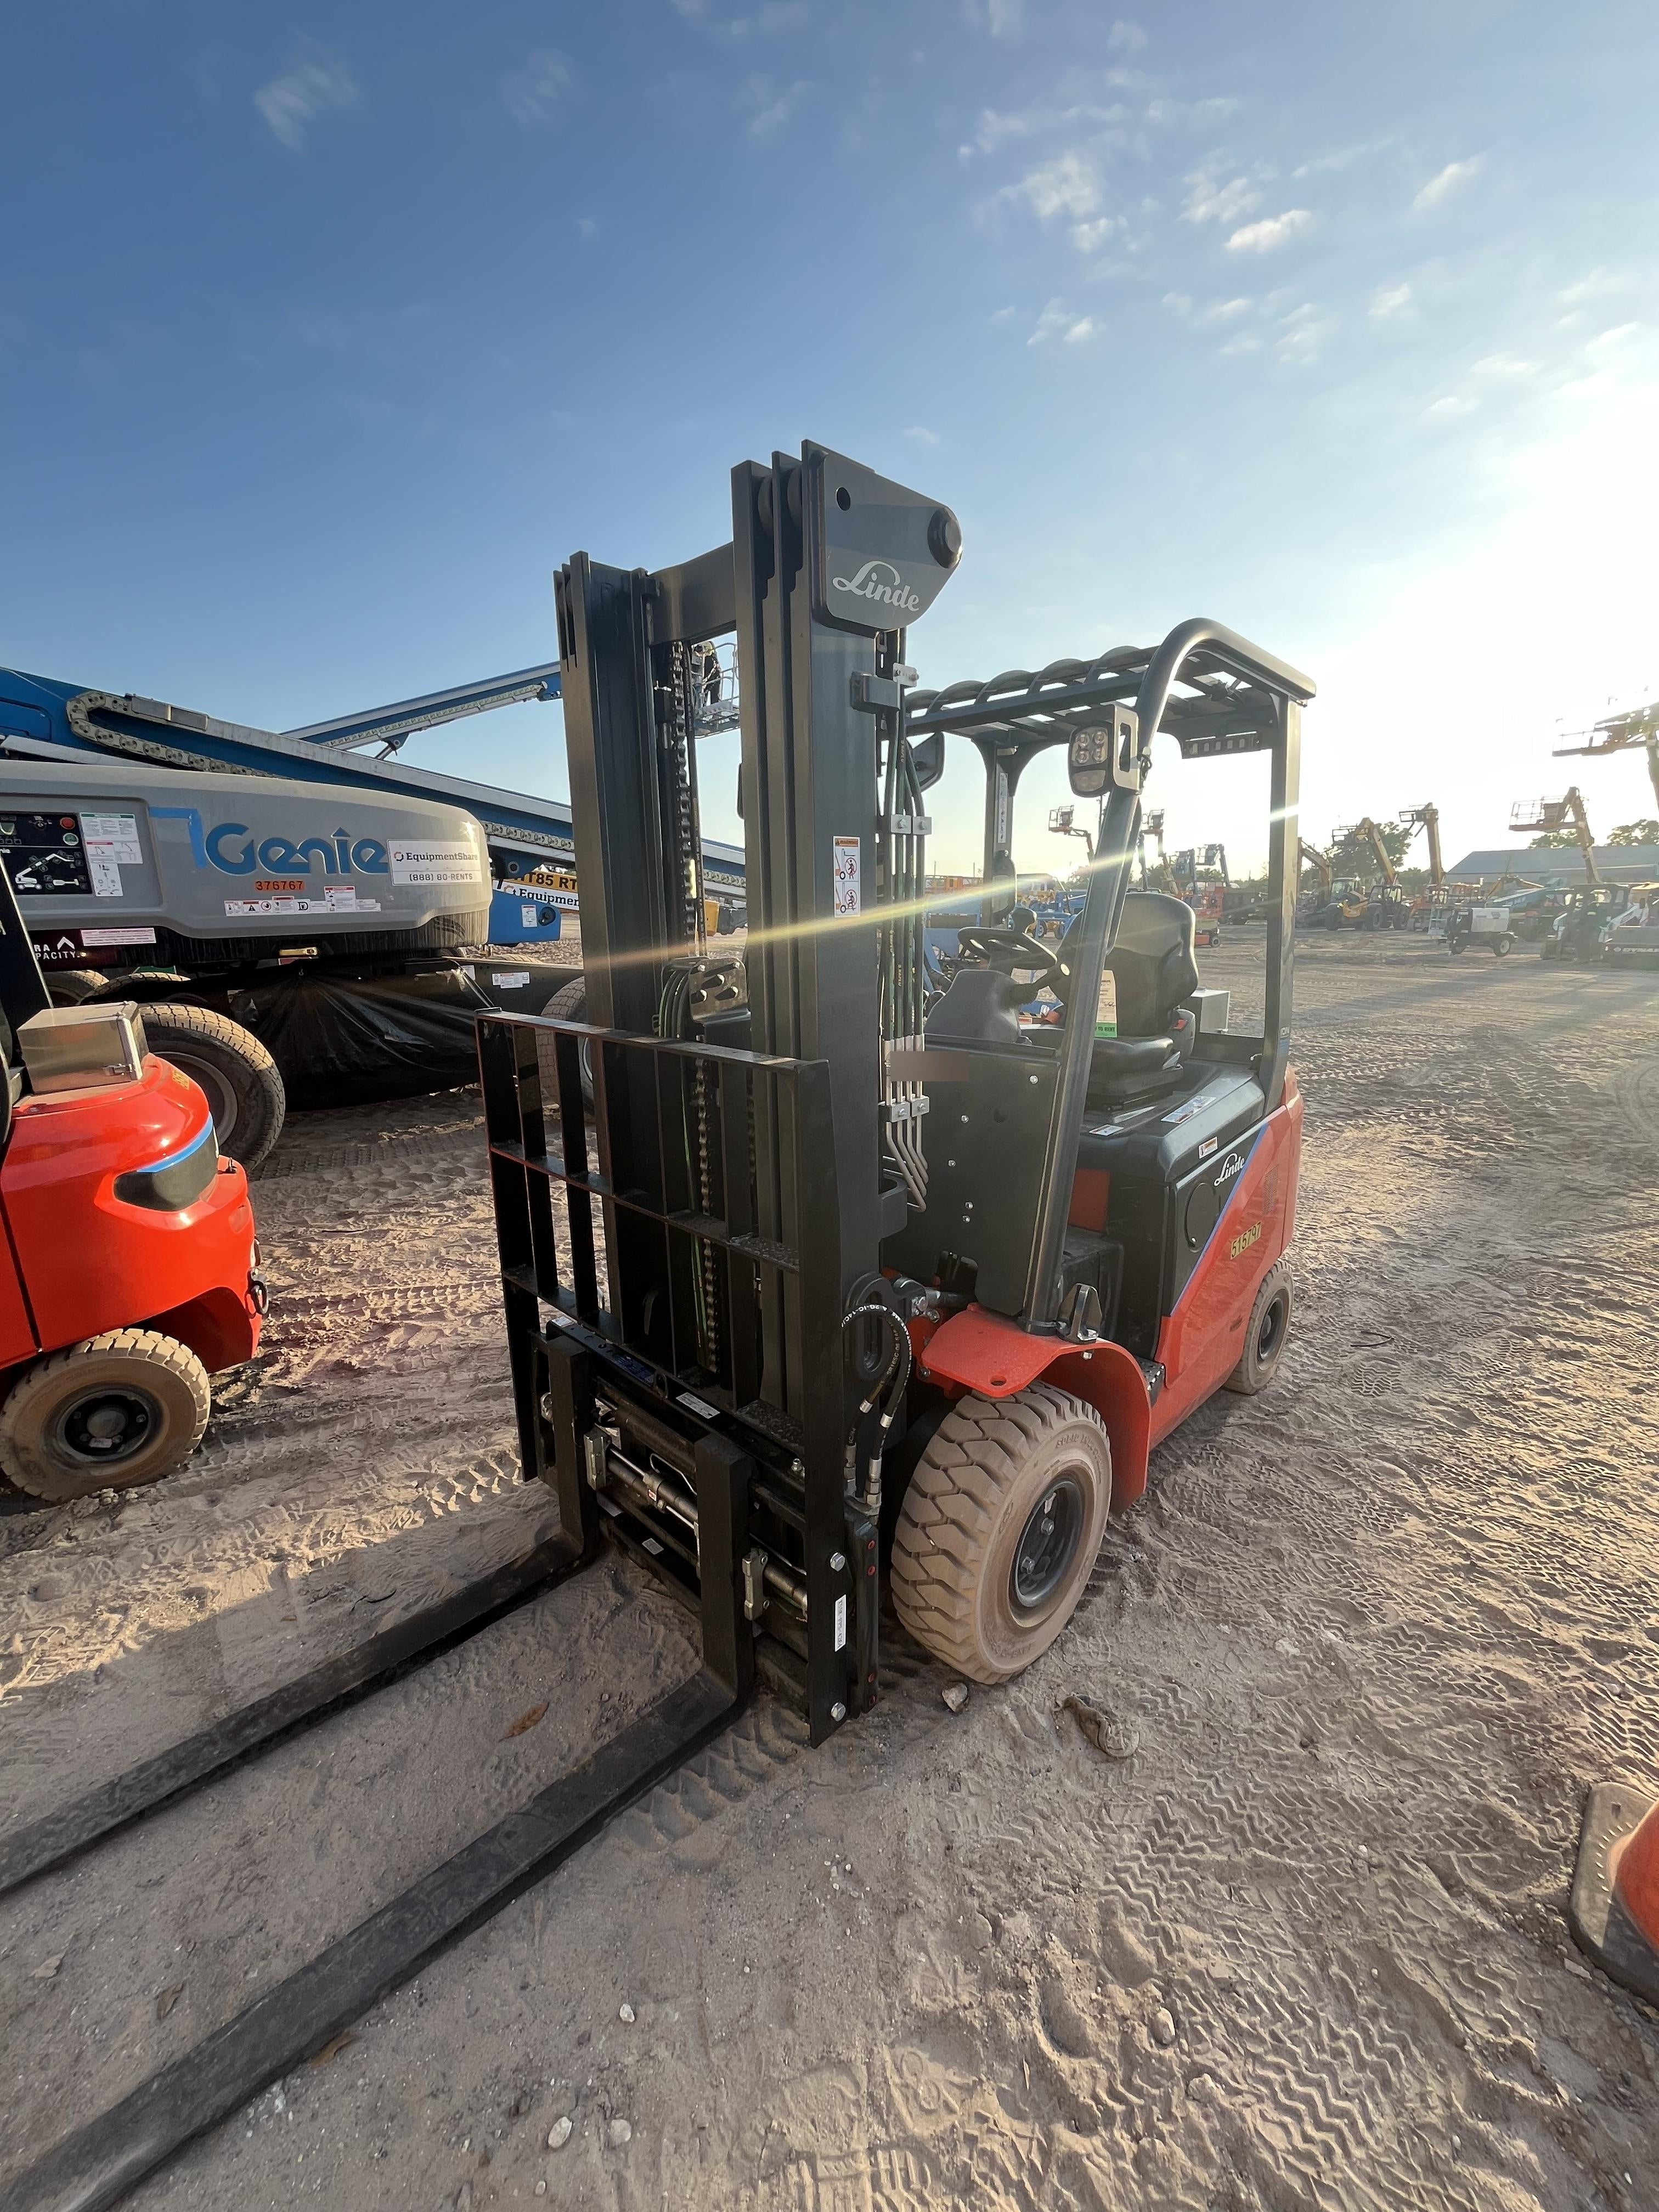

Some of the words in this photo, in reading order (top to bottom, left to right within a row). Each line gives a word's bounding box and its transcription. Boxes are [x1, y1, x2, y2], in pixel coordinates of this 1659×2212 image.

[832, 561, 919, 612] Linde
[205, 822, 388, 876] Genie
[406, 851, 478, 862] EquipmentShare
[256, 881, 303, 890] 376767
[1214, 1153, 1245, 1186] Linde
[1232, 1222, 1261, 1257] 515797
